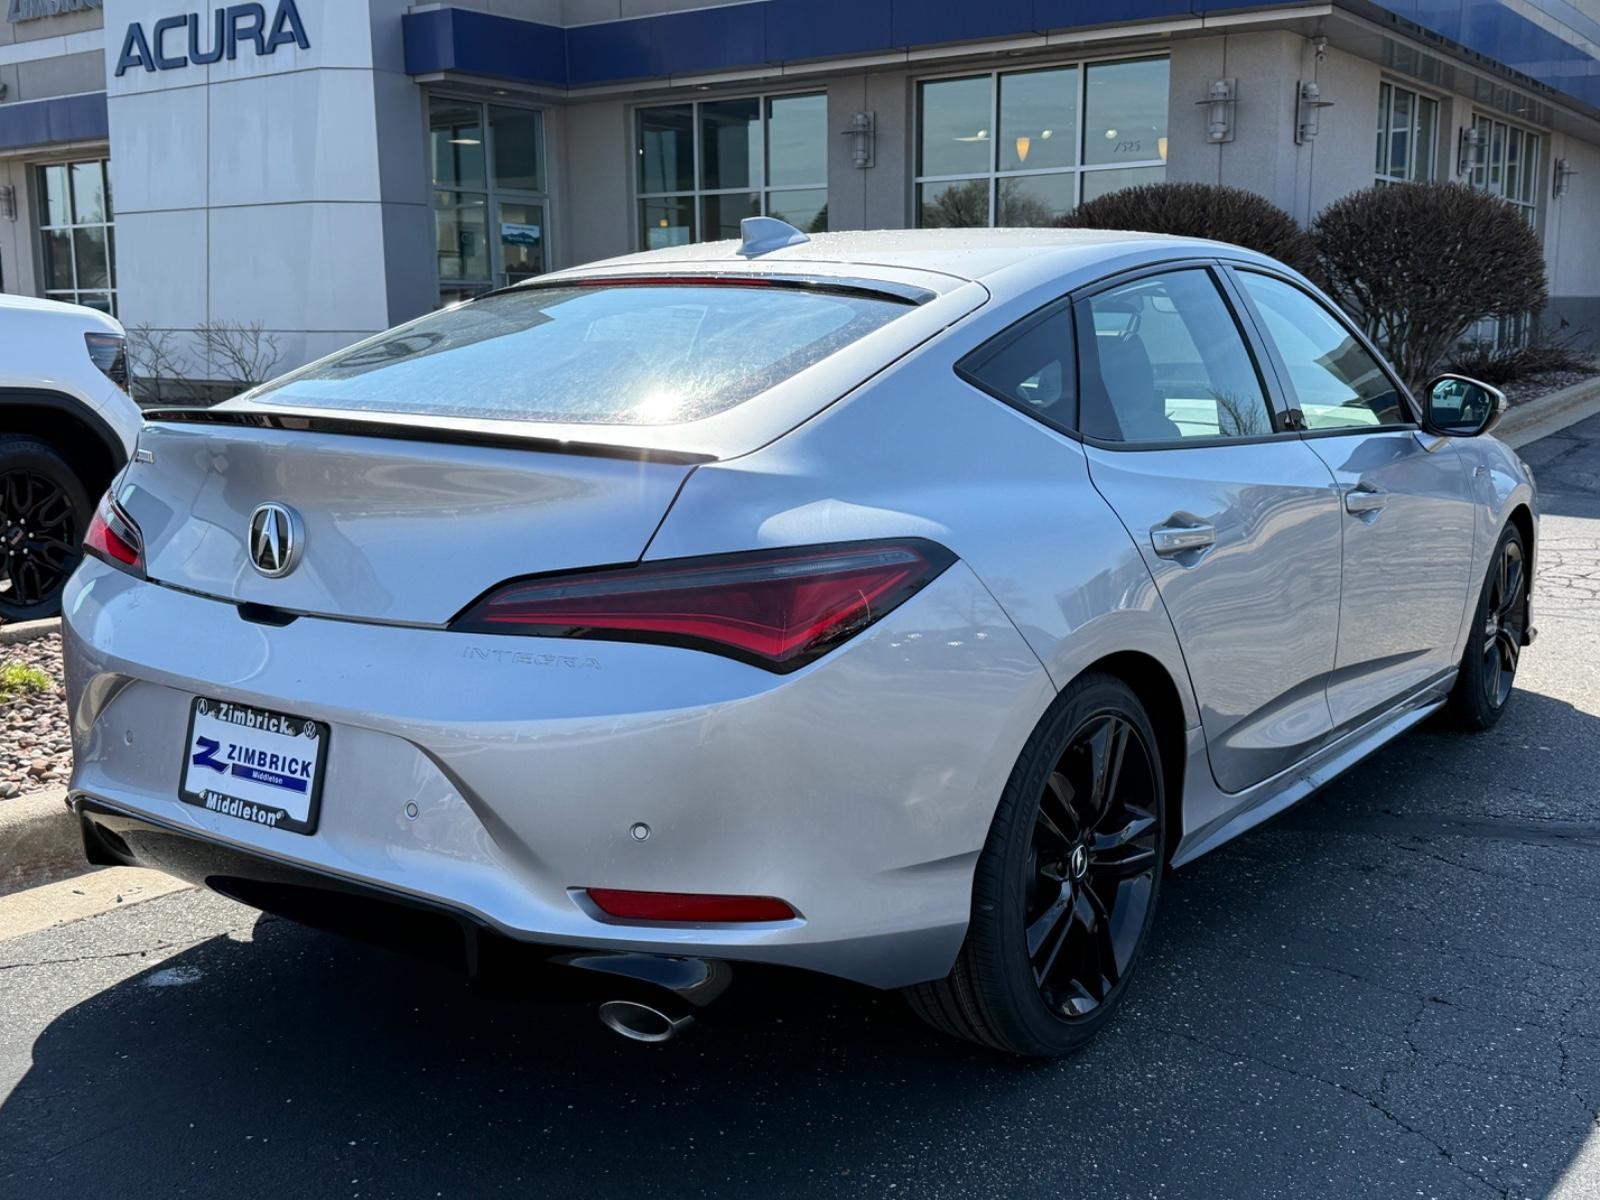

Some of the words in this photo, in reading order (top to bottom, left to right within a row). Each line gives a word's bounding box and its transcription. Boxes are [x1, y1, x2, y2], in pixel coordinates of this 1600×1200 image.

[114, 0, 310, 77] ACURA
[461, 646, 601, 670] INTEGRA
[219, 703, 290, 735] Zimbrick
[227, 744, 312, 778] ZIMBRICK
[206, 792, 275, 825] Middleton
